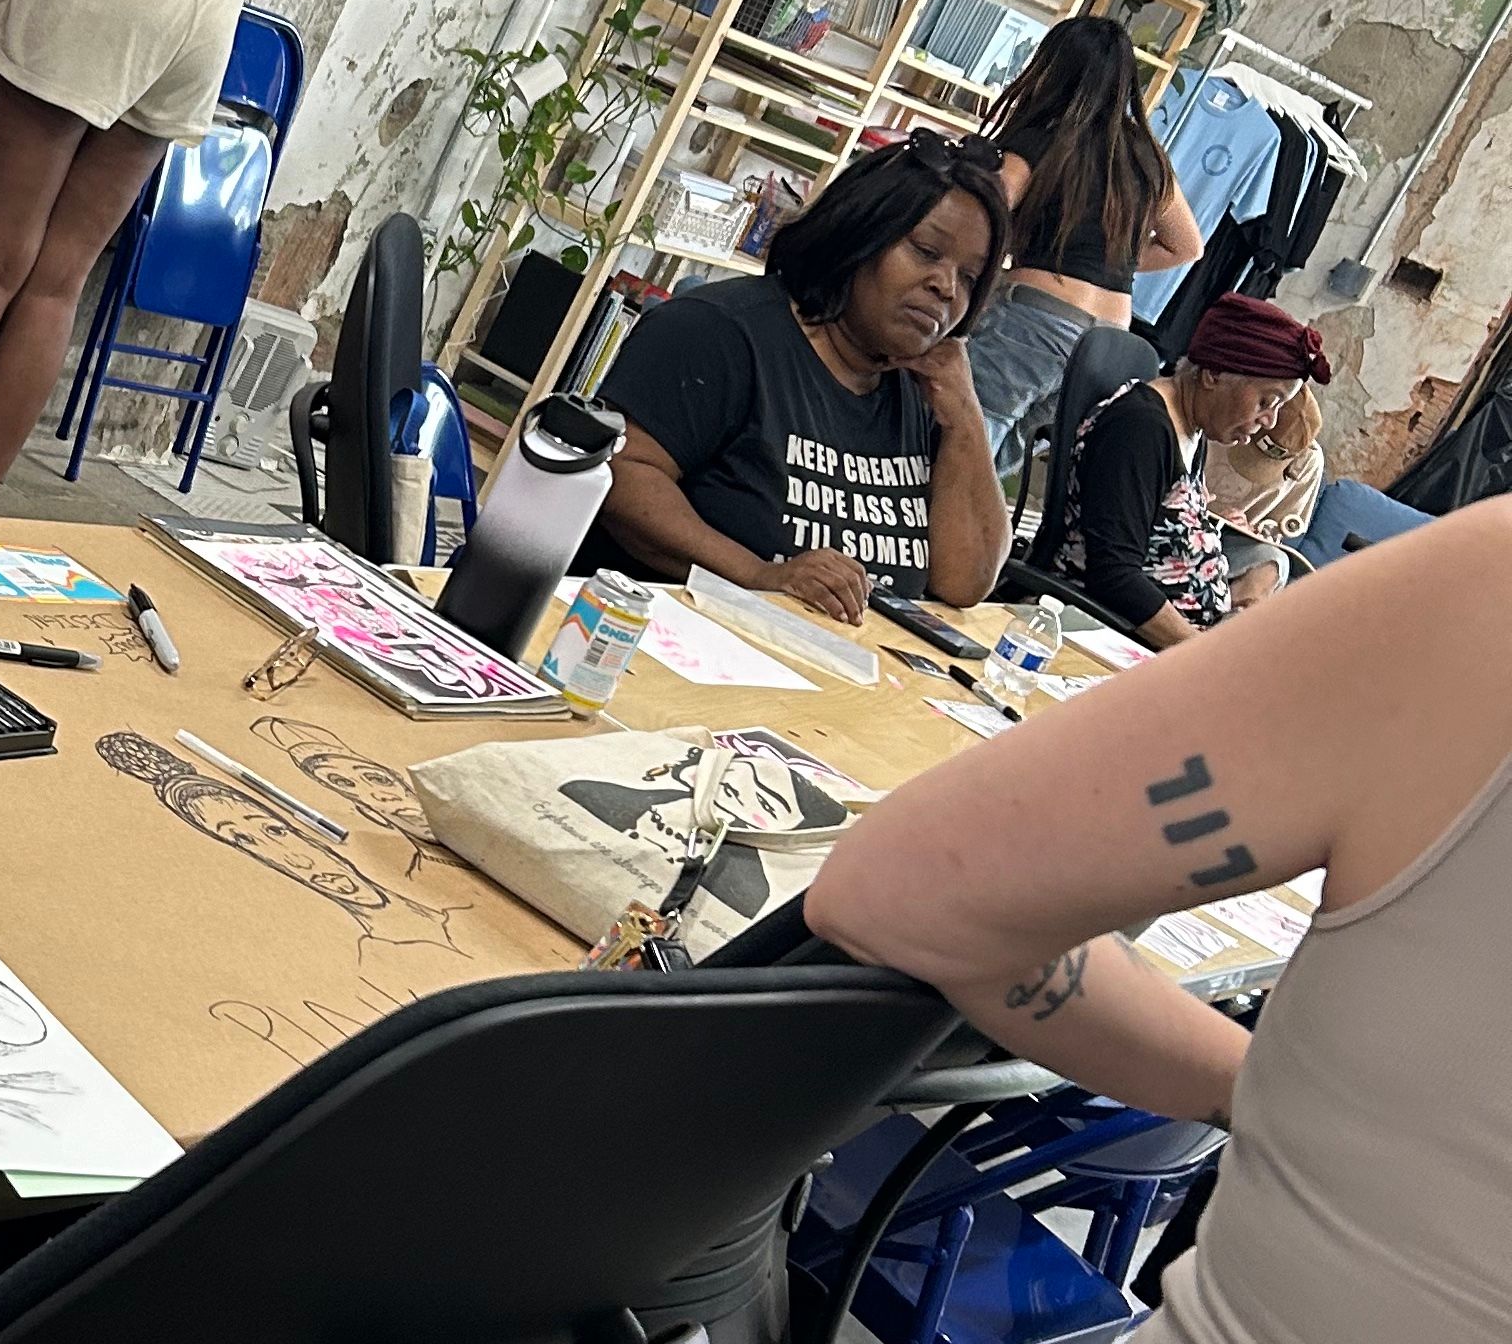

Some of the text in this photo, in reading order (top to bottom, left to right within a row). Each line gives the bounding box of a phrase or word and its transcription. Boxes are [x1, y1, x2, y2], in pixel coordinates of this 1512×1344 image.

[786, 434, 839, 477] KEEP
[786, 475, 849, 519] DOPE
[853, 493, 898, 526] ASS
